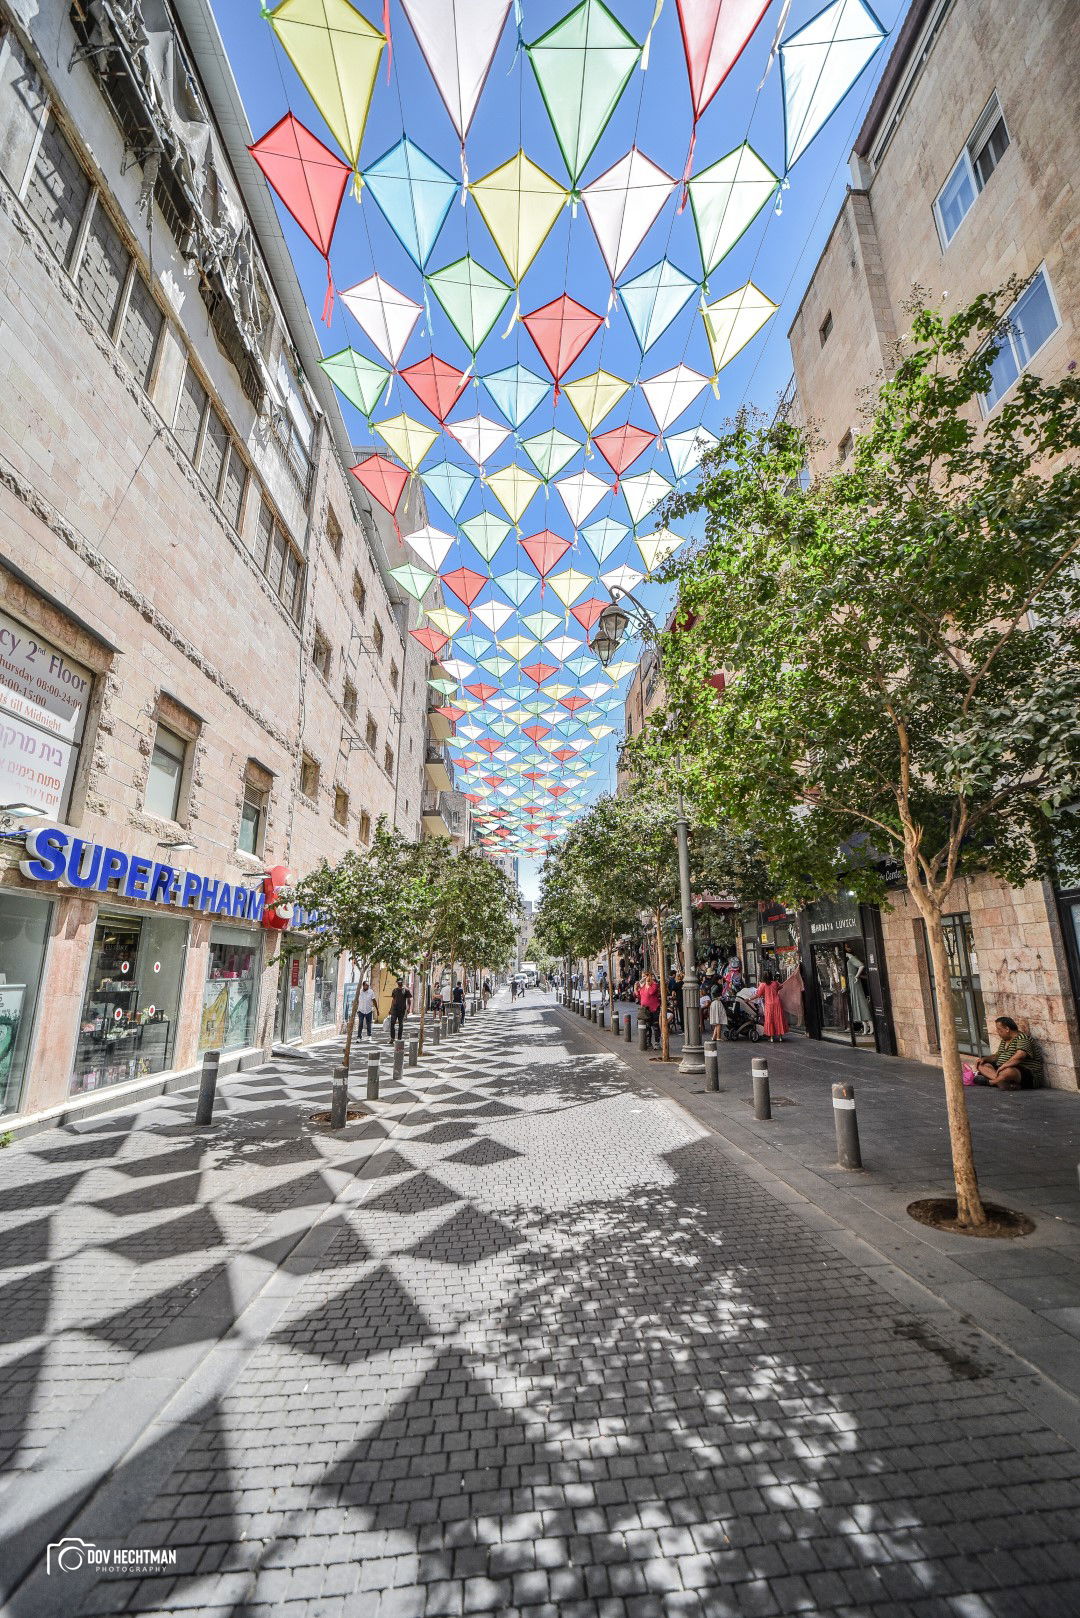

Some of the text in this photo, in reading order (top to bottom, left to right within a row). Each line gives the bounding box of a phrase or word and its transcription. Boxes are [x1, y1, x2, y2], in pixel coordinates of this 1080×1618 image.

[48, 655, 87, 693] Floor
[25, 705, 63, 733] Midnight
[38, 742, 63, 768] בית
[37, 771, 61, 791] פתוח
[20, 828, 266, 922] SUPER-PHARM
